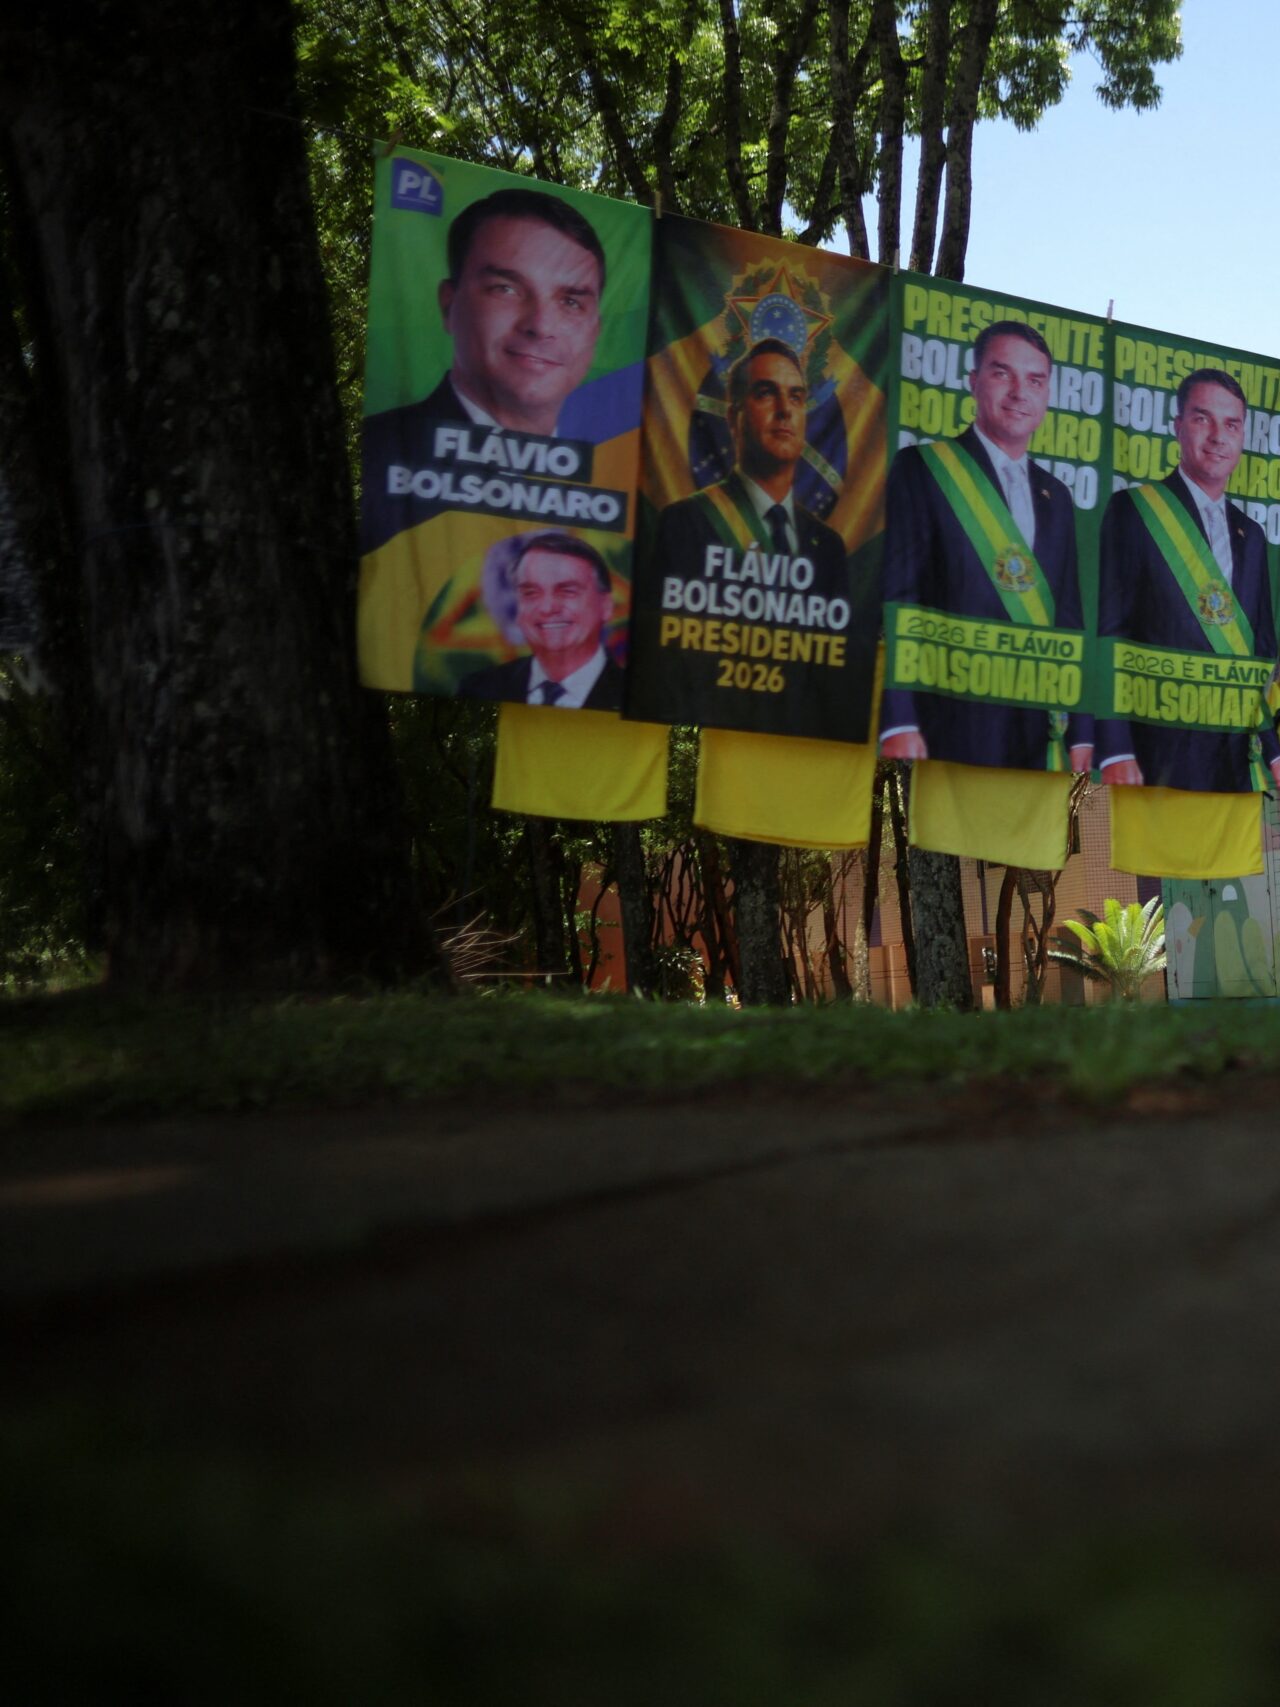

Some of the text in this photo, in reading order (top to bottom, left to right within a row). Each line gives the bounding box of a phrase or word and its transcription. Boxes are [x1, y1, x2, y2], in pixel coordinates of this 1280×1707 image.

[398, 169, 437, 201] PL
[904, 283, 1104, 369] PRESNTE
[901, 332, 1104, 416] BOLARO
[900, 380, 1102, 462] BOLSARO
[434, 426, 580, 476] FLÁVIO
[387, 465, 620, 522] BOLSONARO
[704, 541, 814, 590] FLÁVIO
[661, 577, 850, 630] BOLSONARO
[659, 615, 847, 667] PRESIDENTE
[907, 616, 1075, 658] 2026 É FLÁVIO
[717, 659, 785, 693] 2026
[894, 639, 1082, 706] BOLSONARO
[1122, 651, 1272, 684] 2026 É FLÁVIO
[1113, 671, 1264, 728] BOLSONAR
